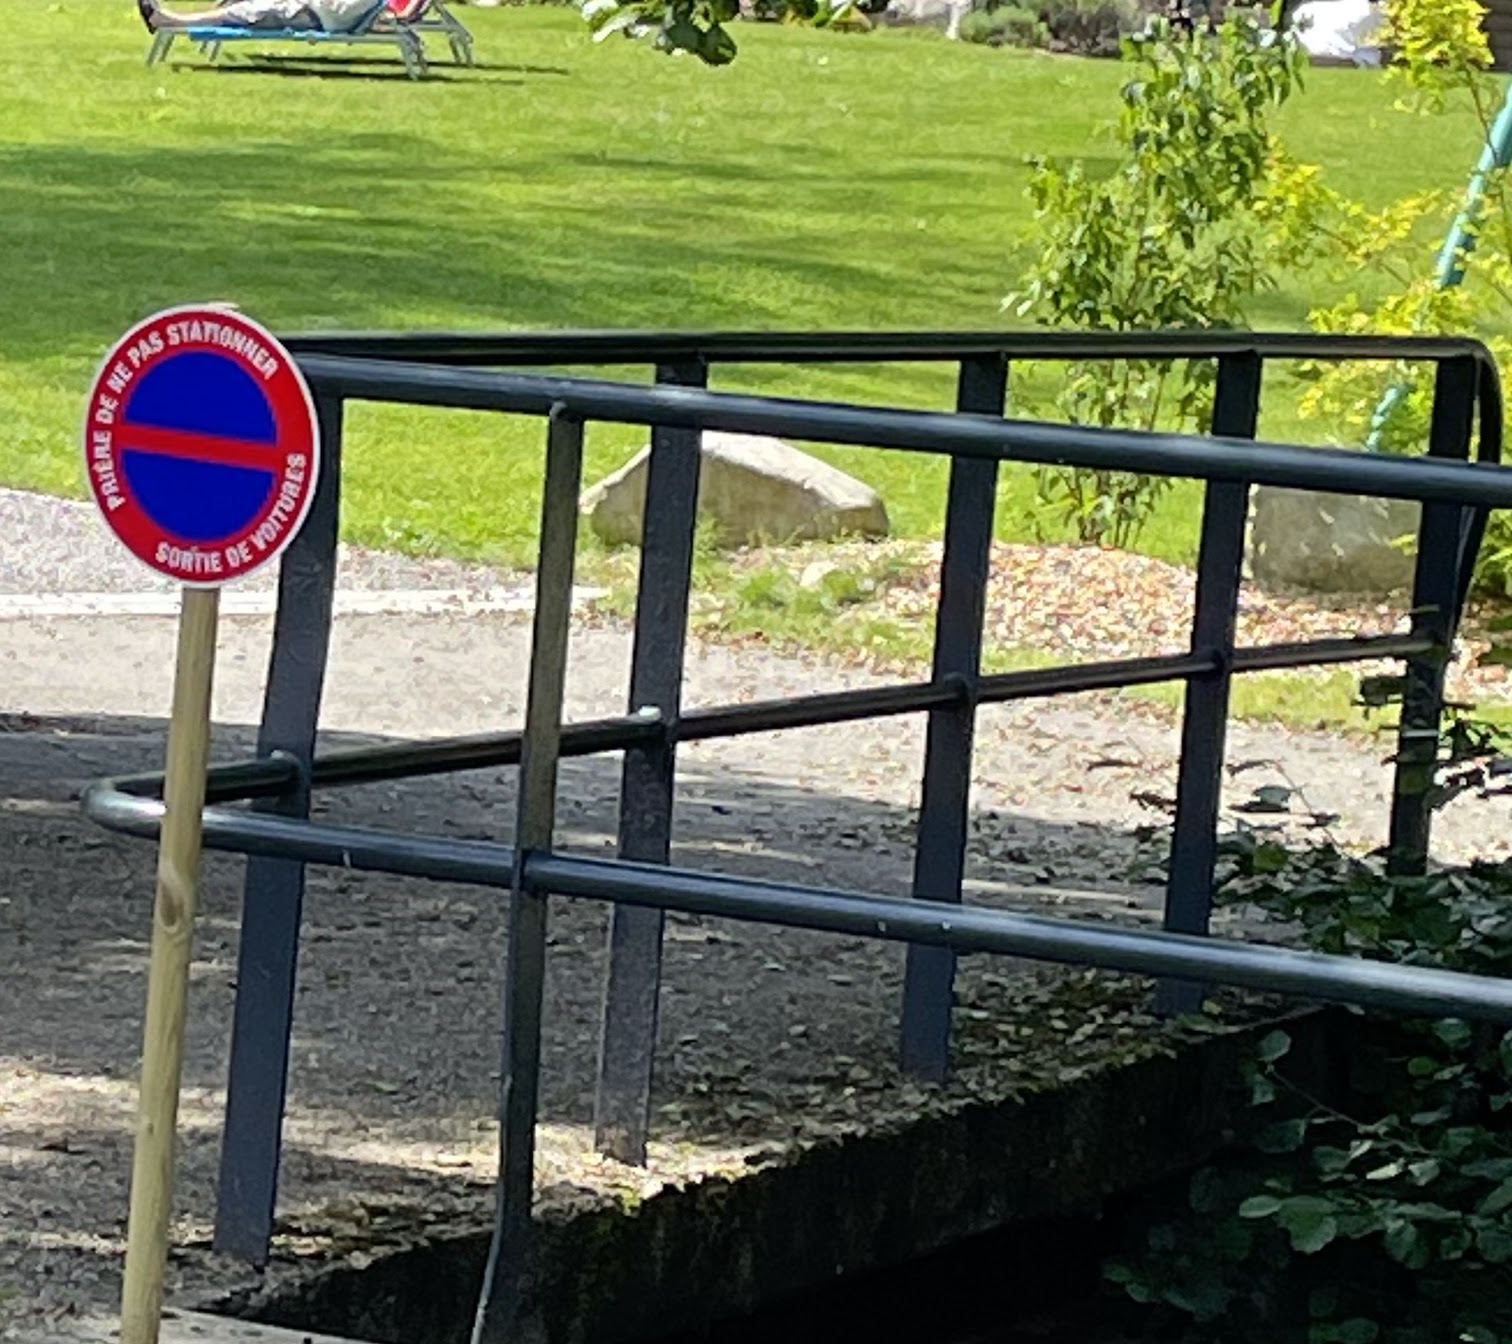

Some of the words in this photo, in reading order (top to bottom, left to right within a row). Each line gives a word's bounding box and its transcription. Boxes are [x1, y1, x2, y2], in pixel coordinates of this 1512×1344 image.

[95, 394, 119, 424] DE
[107, 361, 133, 394] NE
[126, 331, 165, 369] PAS
[166, 319, 279, 380] STATIONNER
[155, 541, 223, 573] SORTIE
[225, 543, 254, 568] DE
[250, 453, 307, 551] VOITURES
